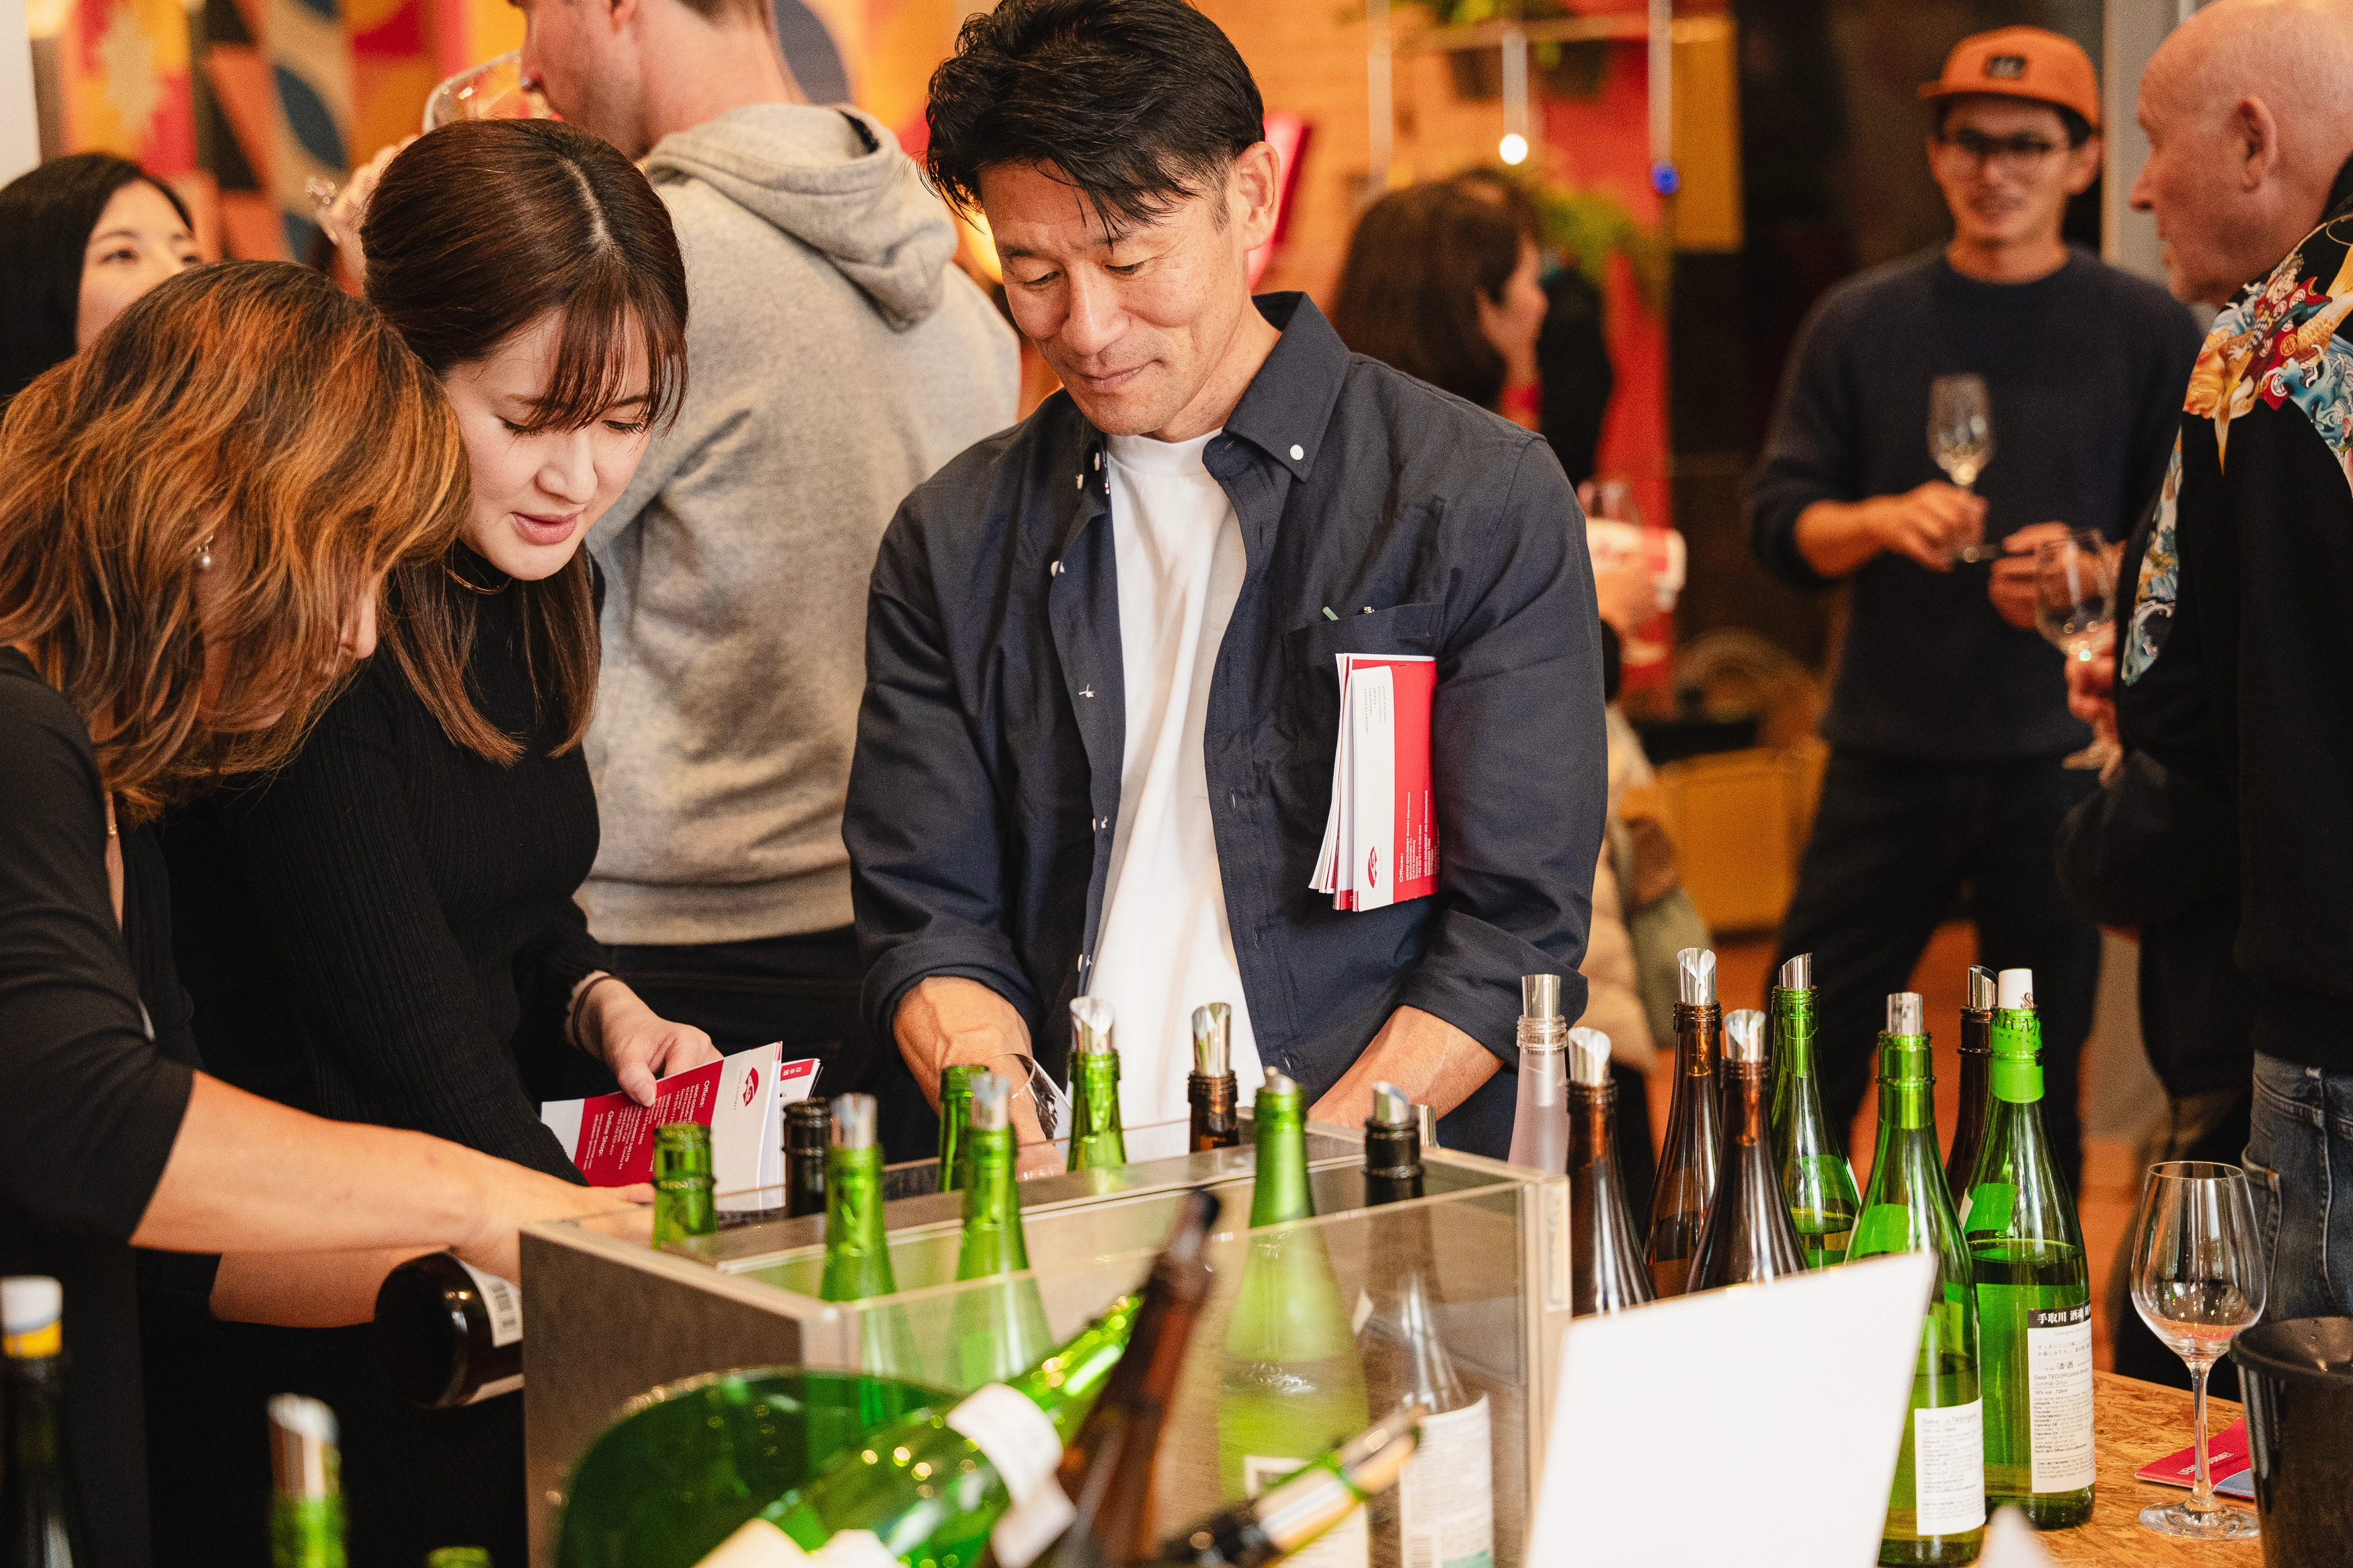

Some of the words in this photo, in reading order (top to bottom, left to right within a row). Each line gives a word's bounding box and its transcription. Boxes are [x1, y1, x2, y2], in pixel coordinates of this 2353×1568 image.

[699, 1080, 709, 1108] Offices:
[2037, 1312, 2067, 1325] 手取川
